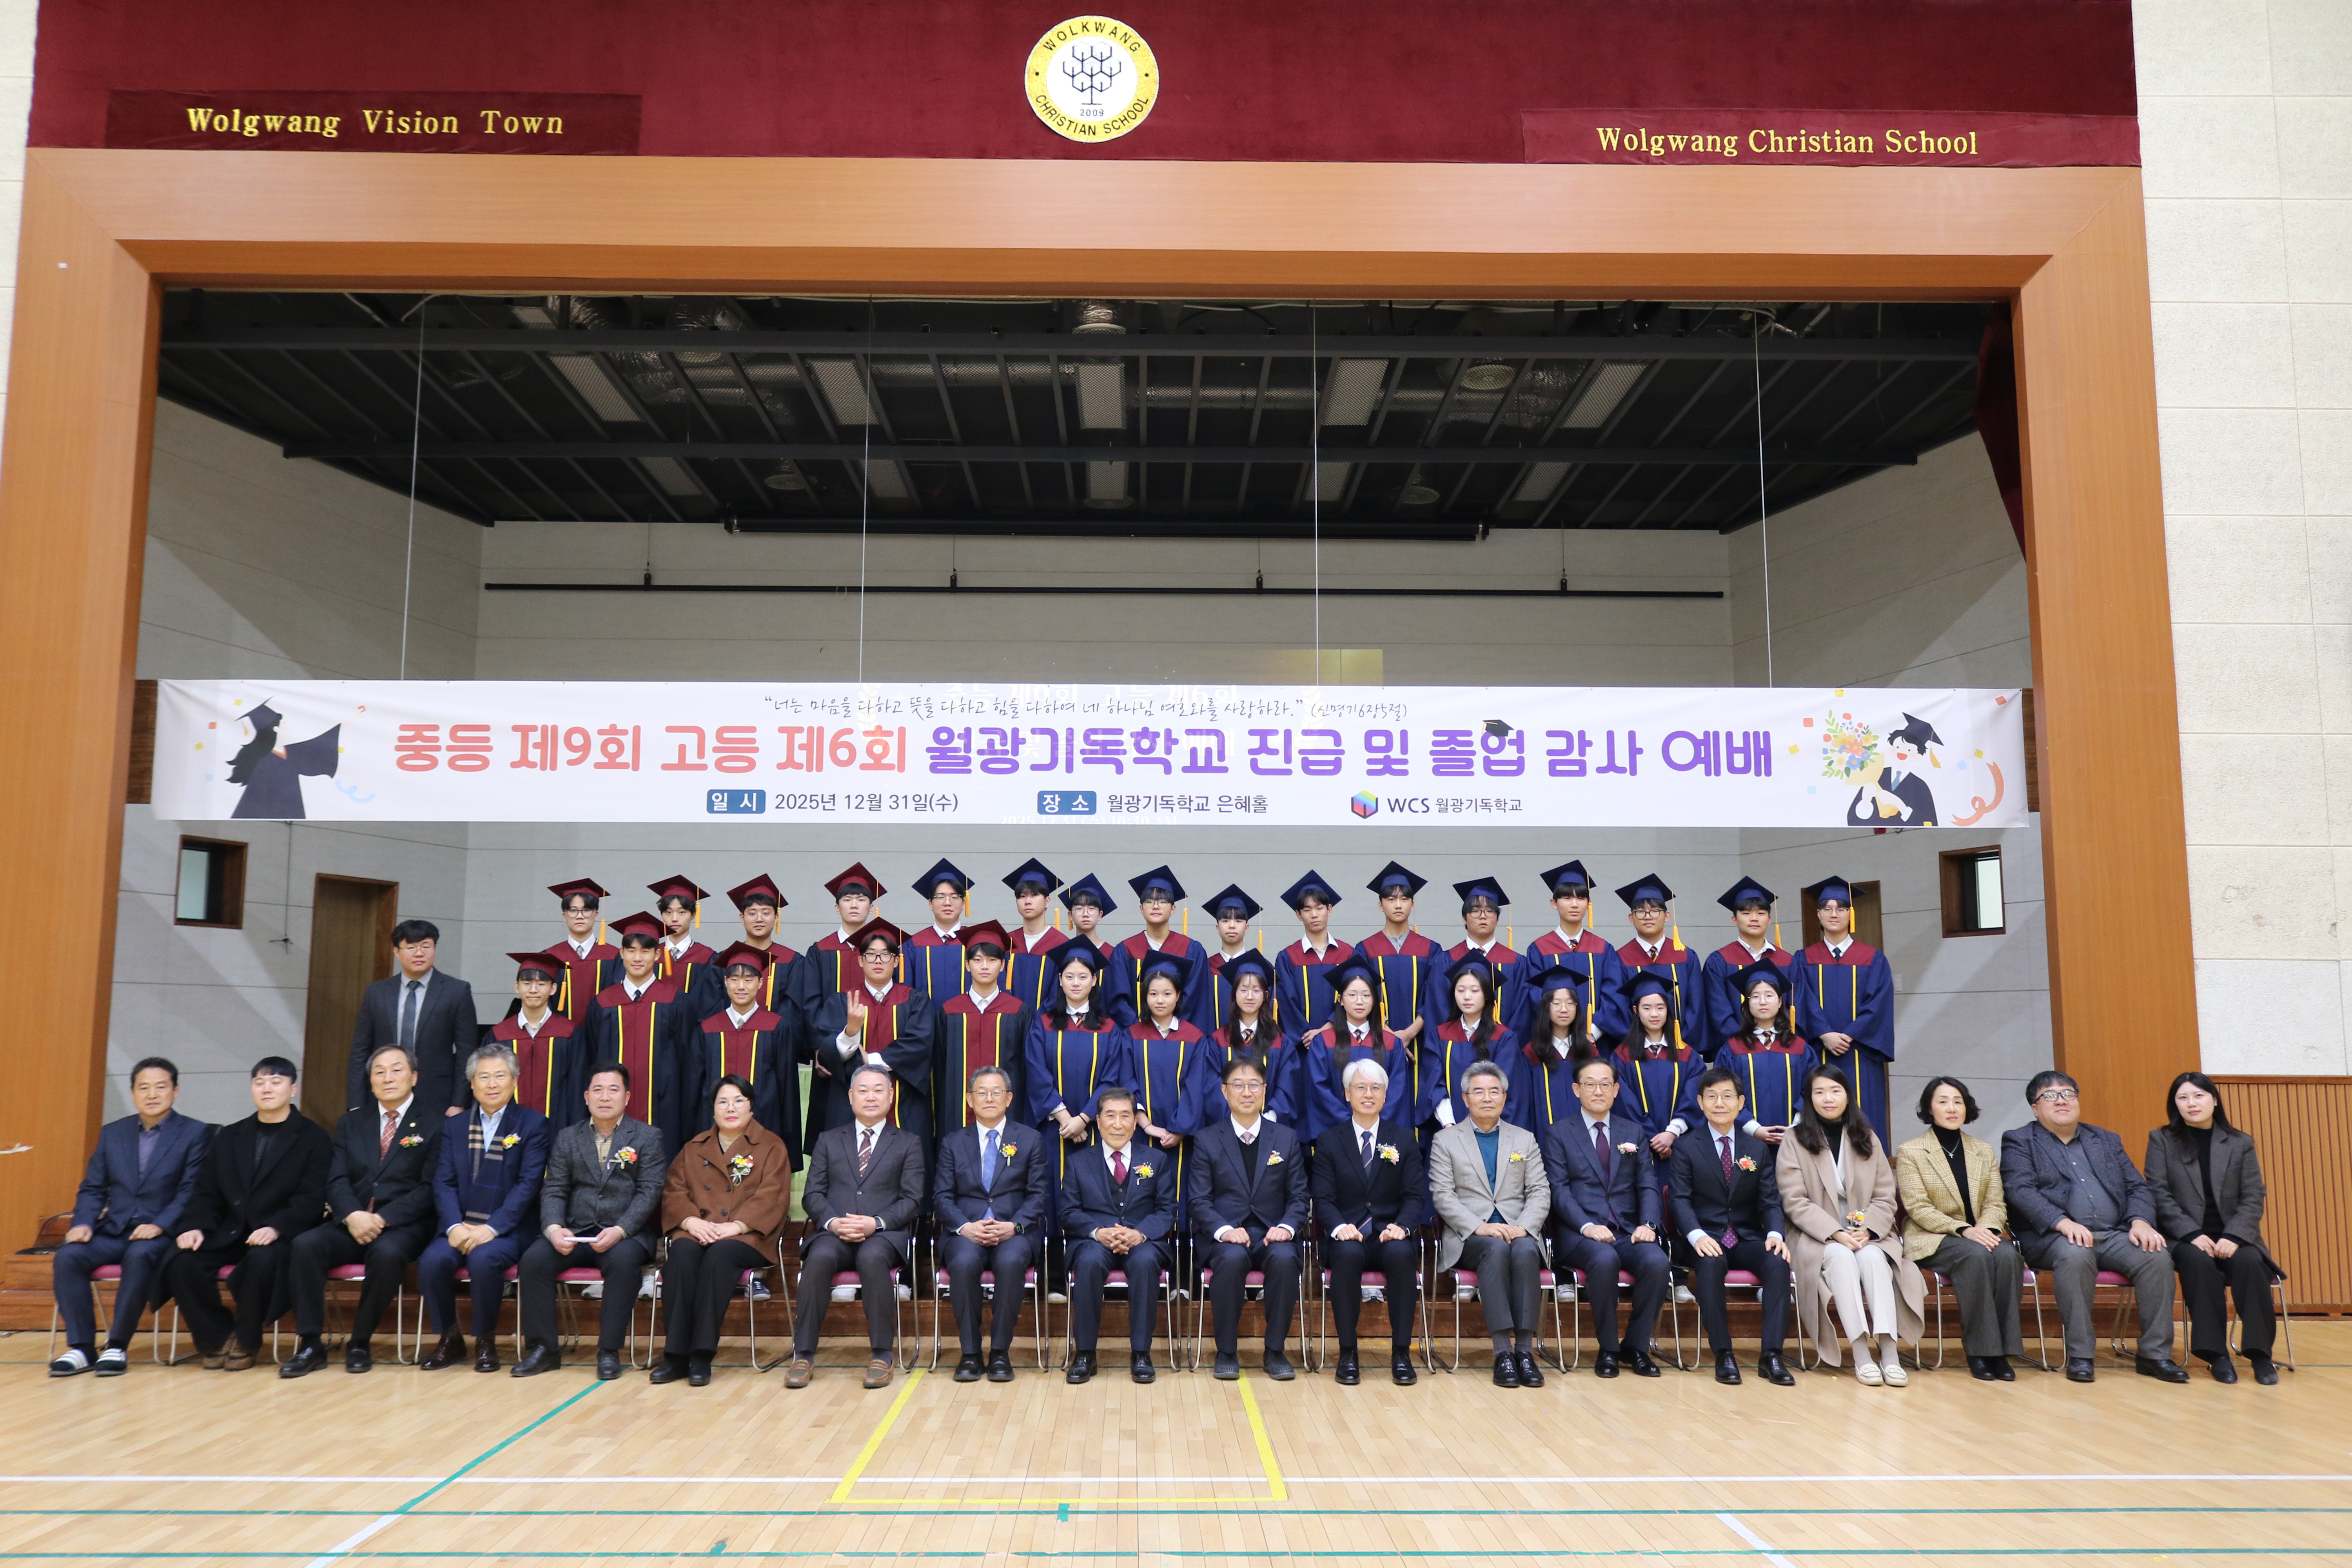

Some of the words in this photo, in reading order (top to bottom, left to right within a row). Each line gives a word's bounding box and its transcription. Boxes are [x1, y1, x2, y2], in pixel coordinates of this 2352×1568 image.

[1044, 22, 1140, 51] WOLKWANG
[187, 108, 340, 137] Wolgwang
[363, 110, 458, 133] Vision
[480, 111, 562, 133] Town
[1036, 95, 1096, 136] CHRISTIAN
[1103, 98, 1149, 134] SCHOOL
[1596, 128, 1738, 156] Wolgwang
[1749, 129, 1874, 152] Christian
[1886, 130, 1978, 154] School
[811, 697, 851, 717] 마음을
[858, 697, 903, 713] 다하고
[910, 697, 934, 720] 뜻을
[941, 697, 985, 714] 다하고
[993, 697, 1019, 719] 힘을
[1027, 698, 1074, 715] 다하여
[1083, 703, 1099, 713] 네
[1107, 698, 1154, 716] 하나님
[1161, 698, 1218, 721] 여호와를
[395, 725, 492, 771] 중등
[511, 724, 640, 771] 제9회
[662, 726, 759, 773] 고등
[777, 725, 906, 772] 제6회
[926, 727, 1229, 775] 월광기독학교
[1249, 729, 1345, 775] 진급
[1365, 730, 1408, 776] 및
[1430, 728, 1524, 777] 졸업
[1546, 730, 1643, 777] 감사
[1662, 731, 1771, 777] 예배
[775, 793, 835, 811] 2025년
[845, 794, 881, 811] 12월
[889, 793, 958, 812] 31일(수)
[1107, 795, 1210, 813] 월광기독학교
[1217, 795, 1268, 813] 은혜홀
[1387, 798, 1430, 813] WCS
[1436, 798, 1522, 813] 월광기독학교
